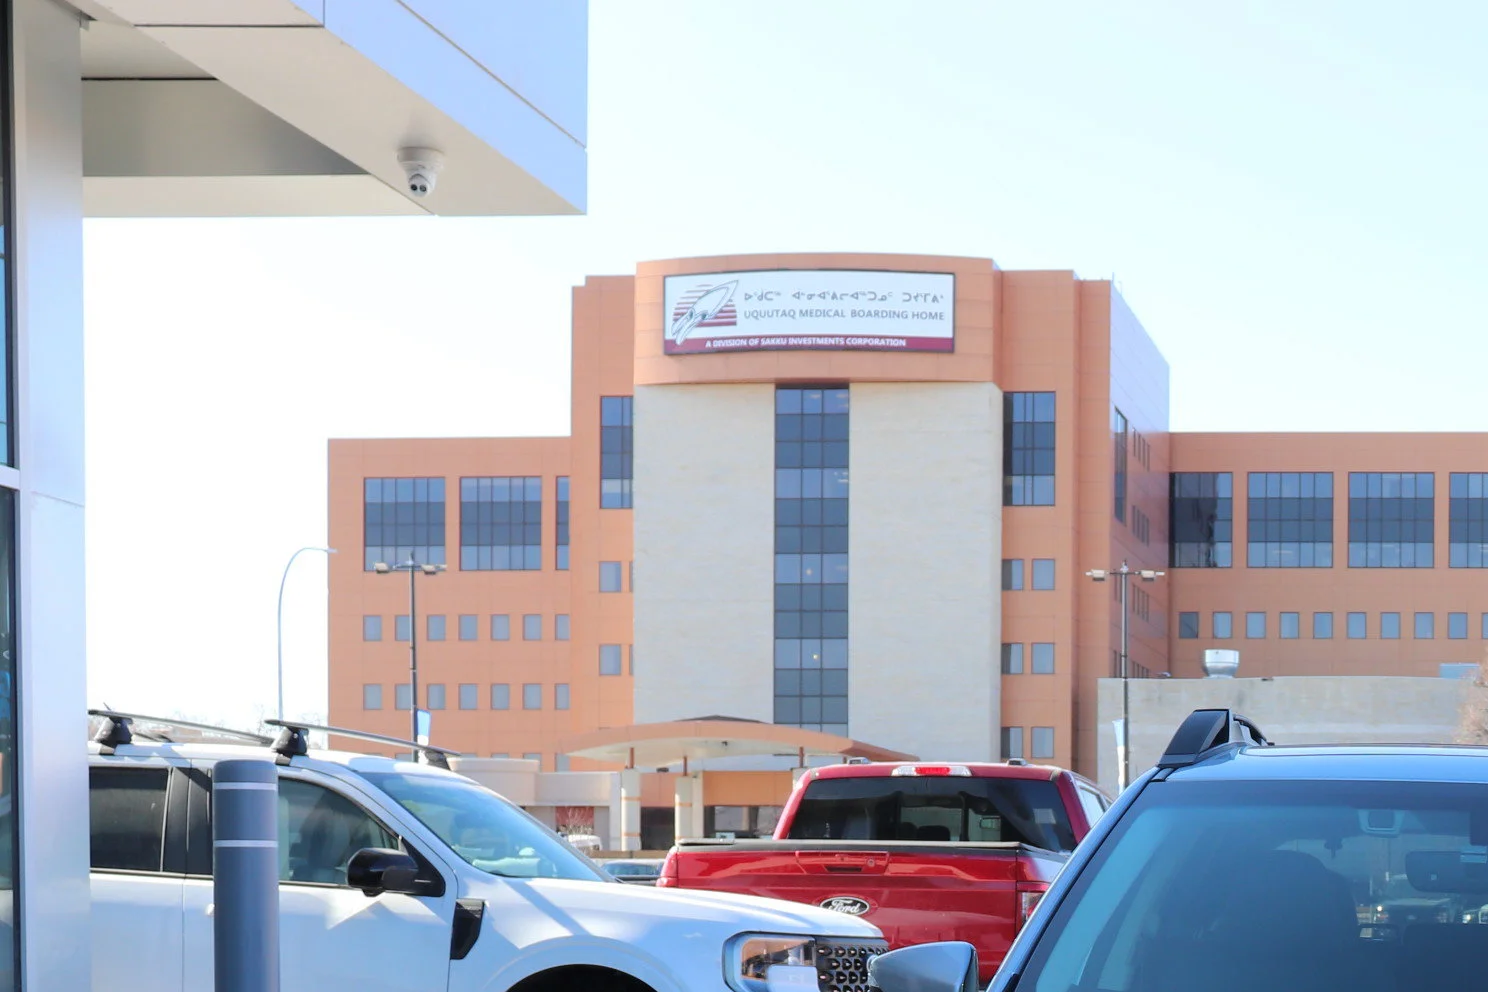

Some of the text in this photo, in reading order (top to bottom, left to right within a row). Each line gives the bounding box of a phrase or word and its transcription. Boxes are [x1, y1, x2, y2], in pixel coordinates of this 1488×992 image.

[744, 308, 944, 320] UQUUTAQ MEDICAL BOARDING HOME
[705, 340, 712, 348] A
[713, 338, 747, 347] DIVISION
[749, 338, 759, 347] OF
[788, 336, 844, 346] INVESTMENTS
[846, 337, 906, 347] CORPORATION
